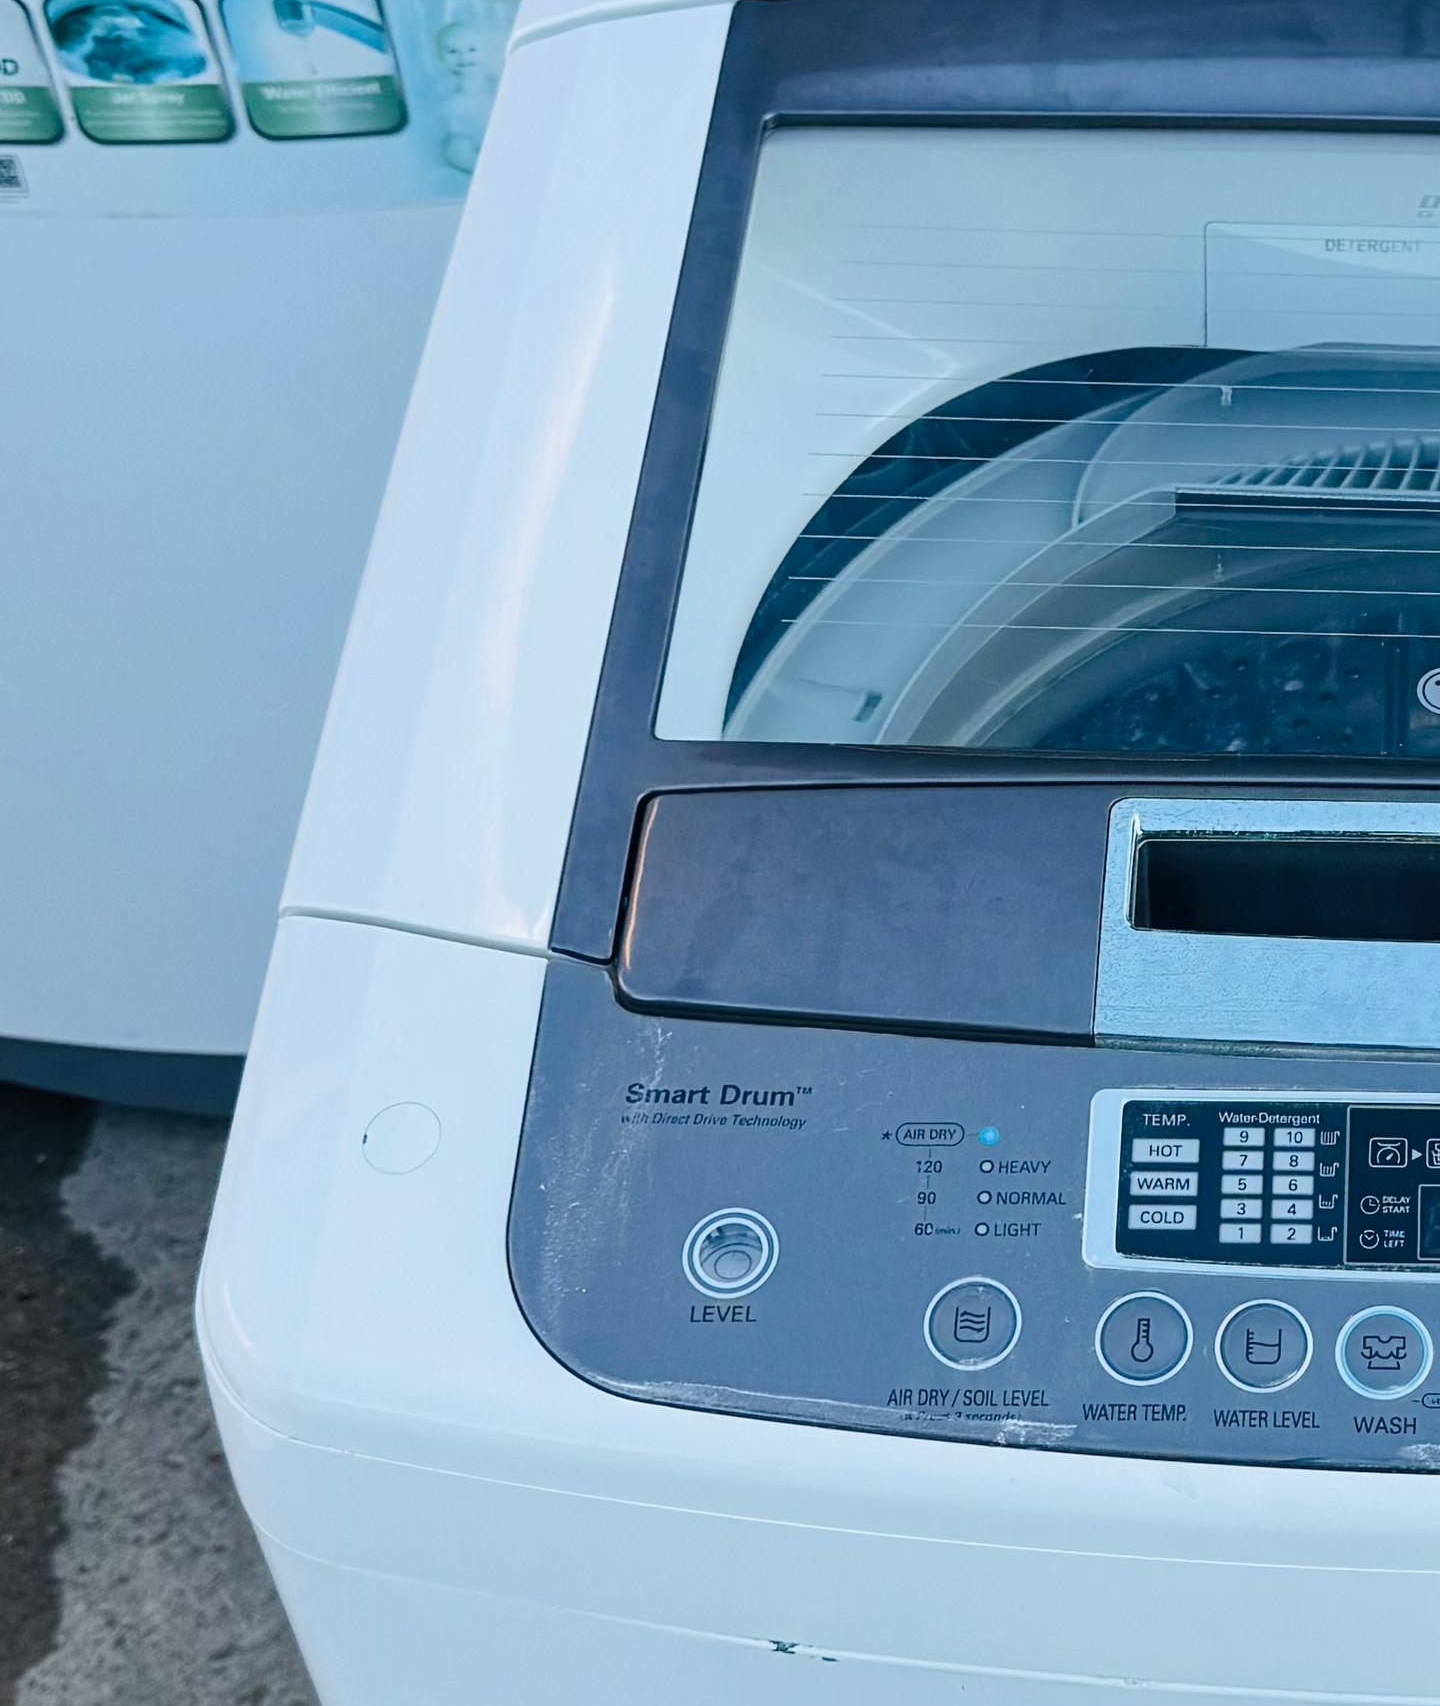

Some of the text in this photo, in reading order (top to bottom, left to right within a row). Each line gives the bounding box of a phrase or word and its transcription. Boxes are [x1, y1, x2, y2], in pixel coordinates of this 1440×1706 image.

[1324, 238, 1421, 254] DETERGENT
[624, 1082, 710, 1107] Smart
[651, 1112, 691, 1127] Direct
[693, 1113, 728, 1129] Drive
[730, 1114, 807, 1131] Technology
[1141, 1112, 1192, 1128] TEMP.
[902, 1126, 957, 1142] AIR DRY
[1239, 1130, 1250, 1145] 9
[1286, 1130, 1304, 1145] 10
[1148, 1142, 1184, 1159] HOT
[915, 1159, 943, 1175] 120
[997, 1159, 1052, 1175] HEAVY
[1238, 1153, 1249, 1168] 7
[1288, 1153, 1300, 1168] 8
[1136, 1176, 1191, 1193] WARM
[1237, 1177, 1248, 1192] 5
[1287, 1177, 1299, 1193] 6
[916, 1190, 937, 1206] 90
[994, 1190, 1068, 1207] NORMAL
[1381, 1195, 1412, 1205] DELAY
[1138, 1209, 1186, 1225] COLD
[1236, 1201, 1247, 1217] 3
[1286, 1202, 1298, 1217] 4
[1382, 1205, 1411, 1214] START
[992, 1222, 1043, 1238] LIGHT
[1237, 1226, 1245, 1241] 1
[1286, 1226, 1297, 1241] 2
[1383, 1229, 1406, 1239] TIME
[1383, 1239, 1406, 1249] LEFT
[689, 1304, 758, 1324] LEVEL
[886, 1388, 914, 1407] AIR
[917, 1388, 950, 1407] DRY
[962, 1389, 998, 1407] SOIL
[1002, 1389, 1050, 1408] LEVEL
[1082, 1402, 1188, 1423] WATER TEMP.
[1213, 1409, 1321, 1431] WATER LEVEL
[1353, 1416, 1418, 1436] WASH
